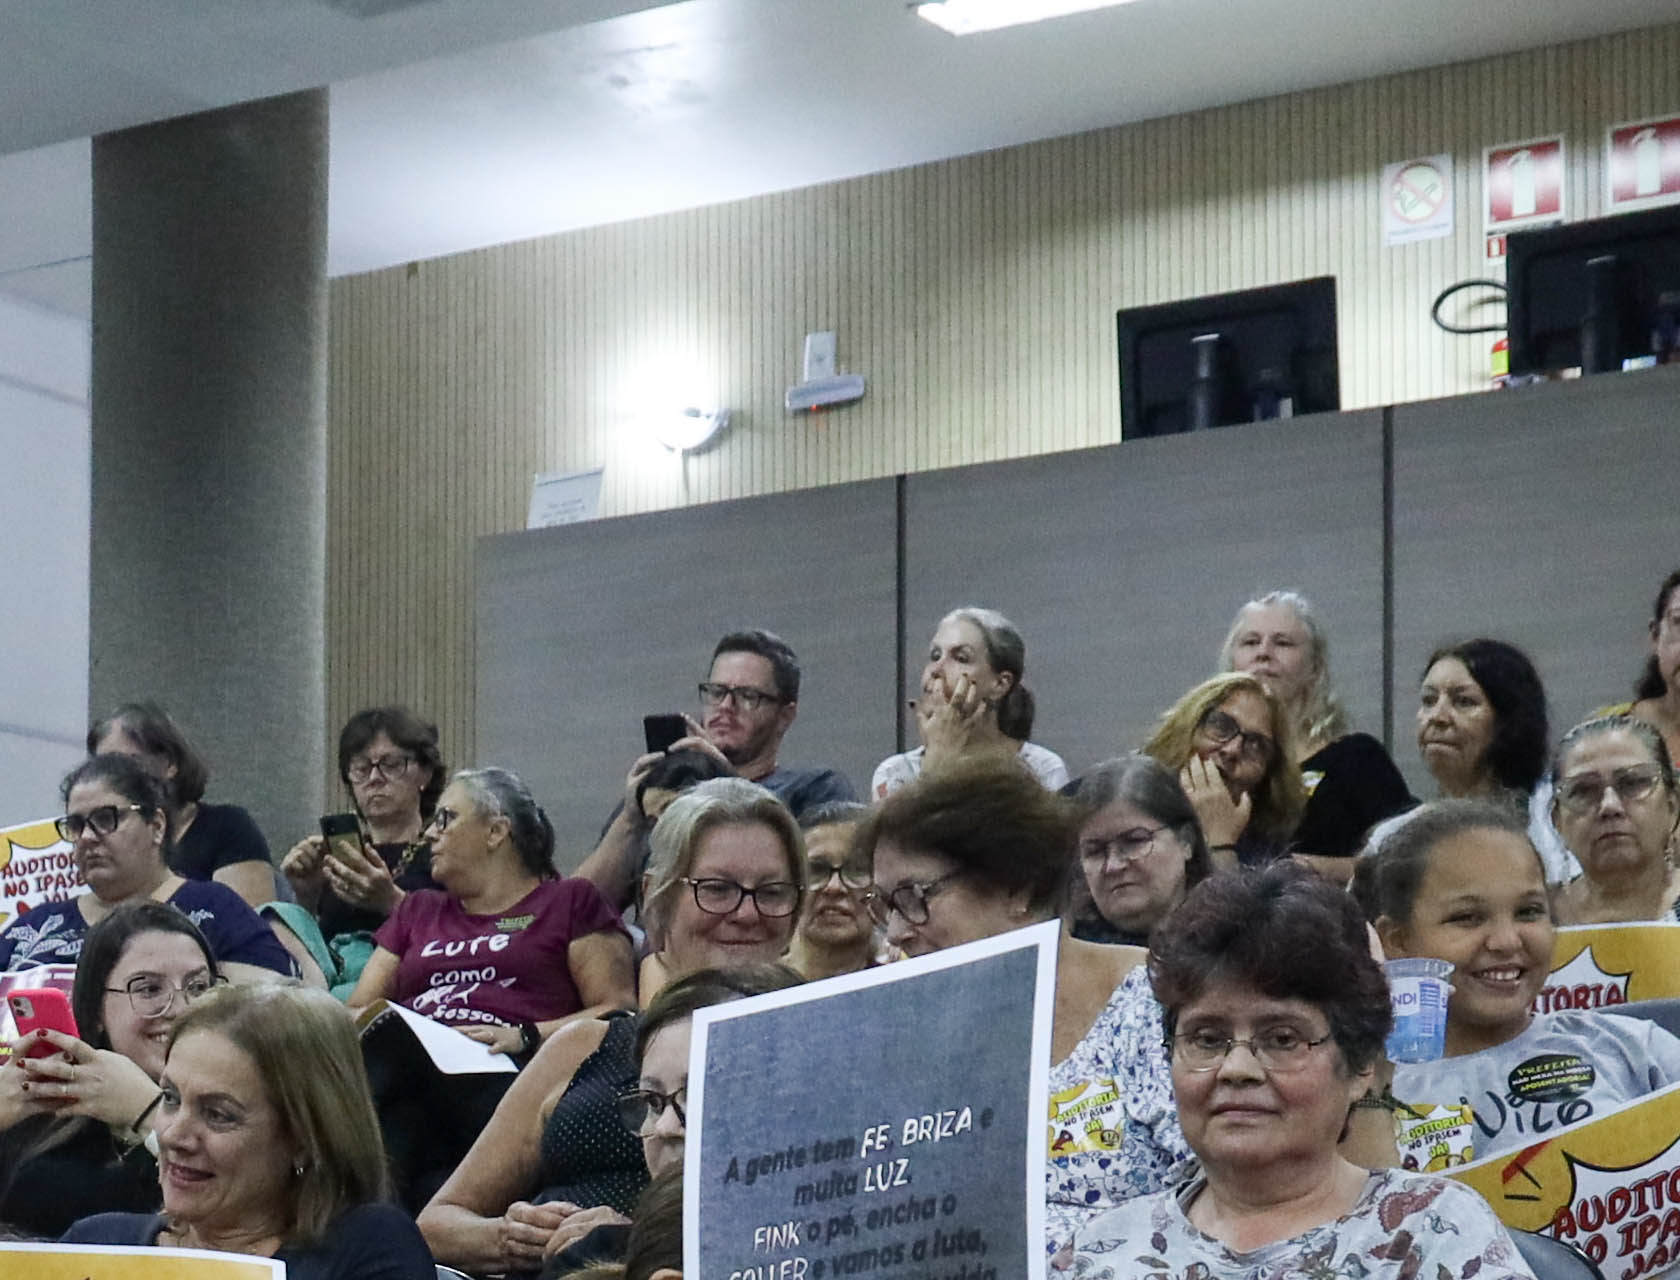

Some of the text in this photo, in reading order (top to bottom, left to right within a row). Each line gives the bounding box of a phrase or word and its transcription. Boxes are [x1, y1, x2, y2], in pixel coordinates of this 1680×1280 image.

[4, 881, 29, 898] NO
[724, 1106, 994, 1186] A gente tem BRIZA e
[1408, 1128, 1462, 1151] NO IPASEM
[794, 1172, 858, 1206] muita
[754, 1222, 802, 1253] FINK
[807, 1225, 820, 1242] o
[866, 1195, 937, 1230] encha
[942, 1194, 957, 1216] o
[812, 1260, 825, 1280] e
[832, 1241, 905, 1277] vamos
[912, 1240, 925, 1261] a
